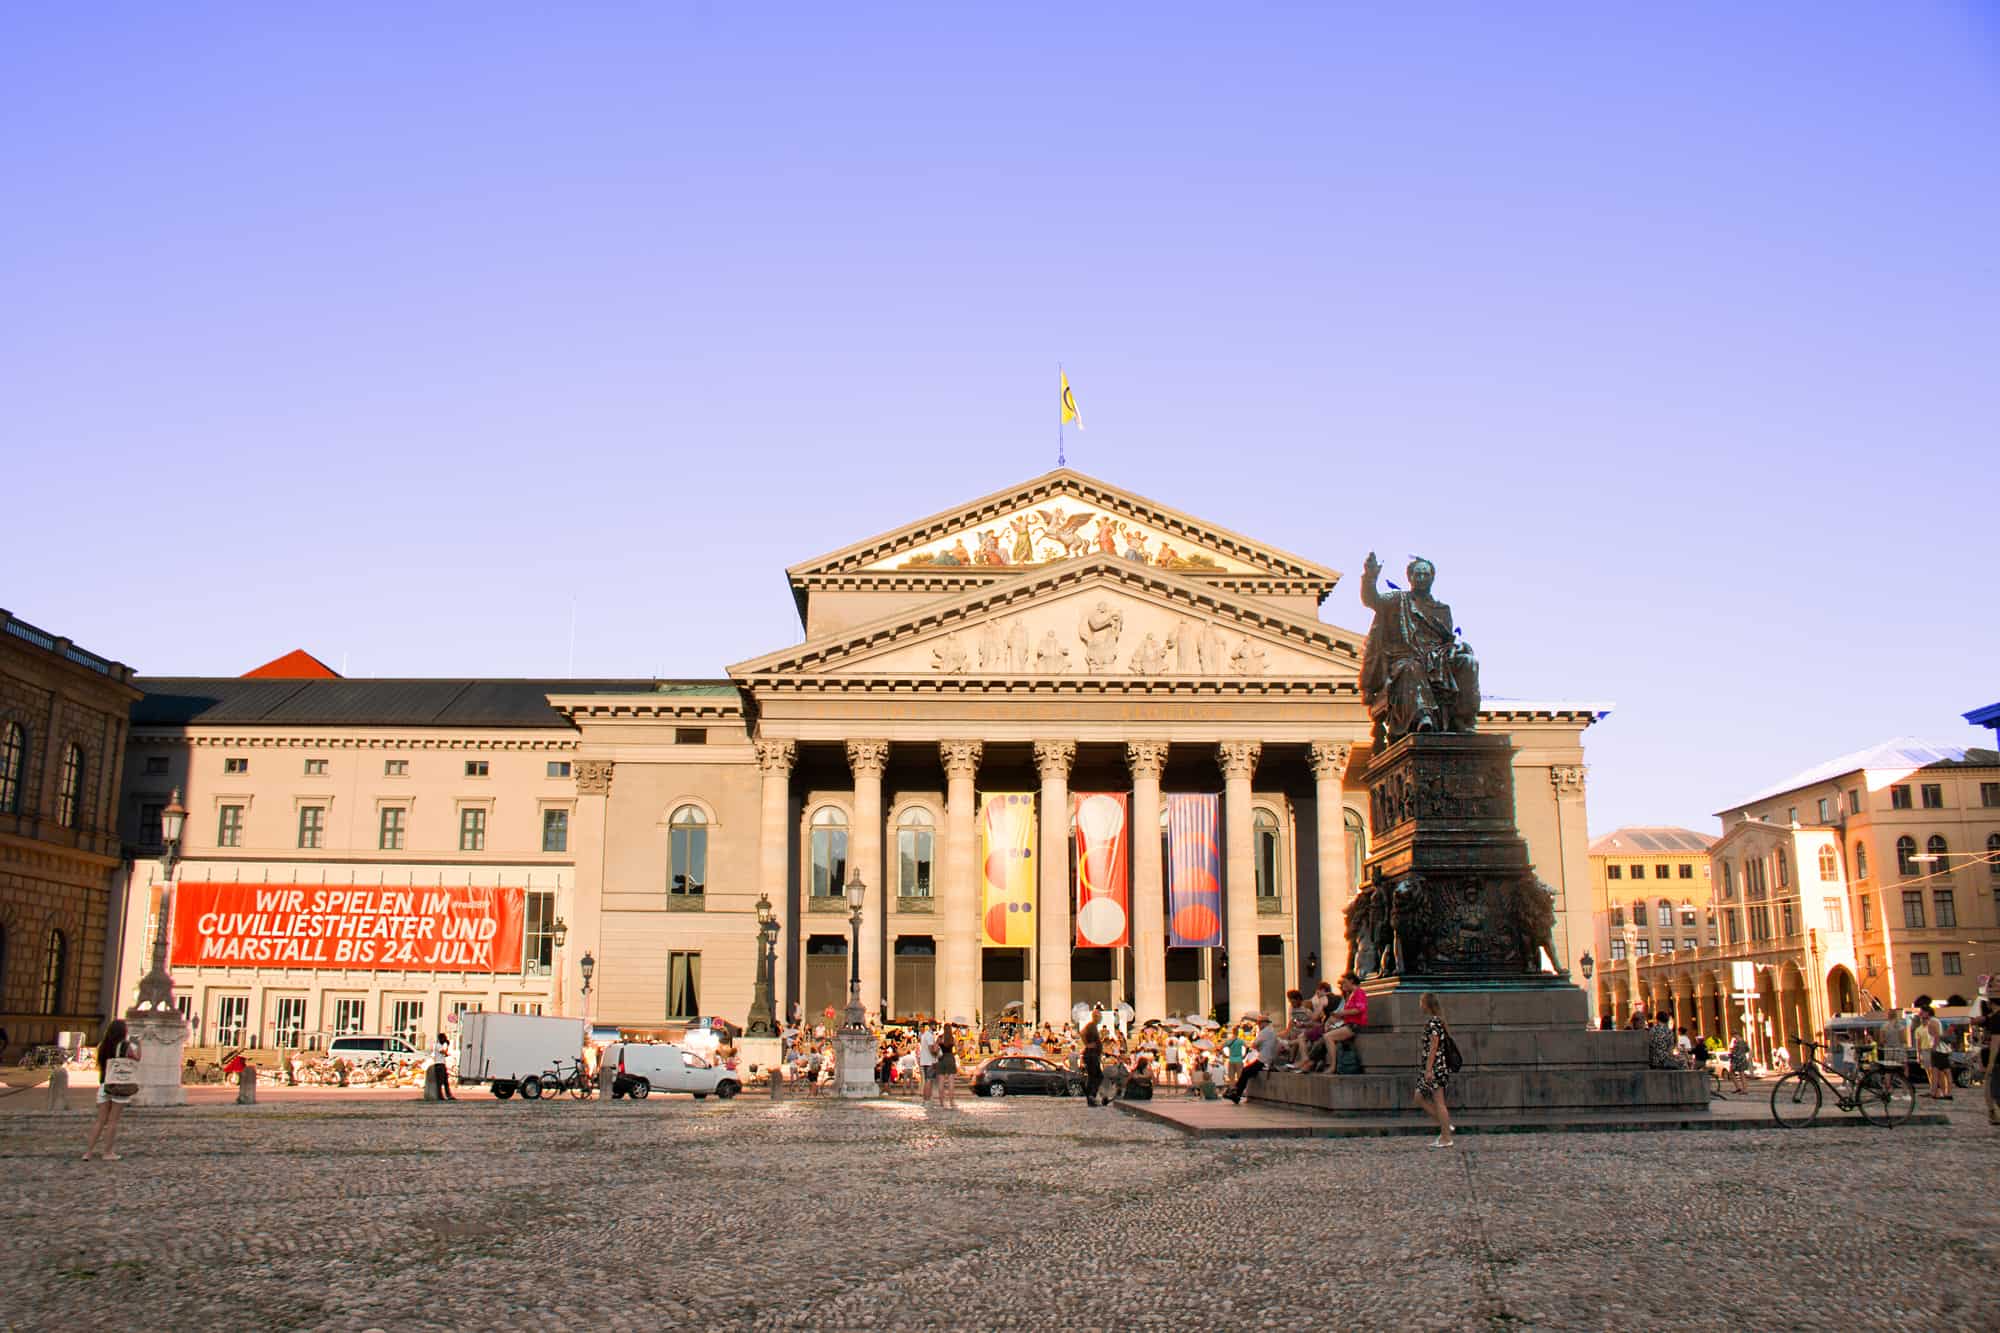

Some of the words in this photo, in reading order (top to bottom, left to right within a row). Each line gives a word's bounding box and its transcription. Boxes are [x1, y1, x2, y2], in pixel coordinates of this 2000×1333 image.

[256, 890, 304, 912] WIR
[311, 890, 414, 914] SPIELEN
[420, 892, 451, 915] IM
[198, 909, 435, 939] CUVILLIÉSTHEATER
[441, 917, 497, 940] UND
[202, 937, 327, 961] MARSTALL
[335, 939, 375, 963] BIS
[379, 941, 419, 964] 24.
